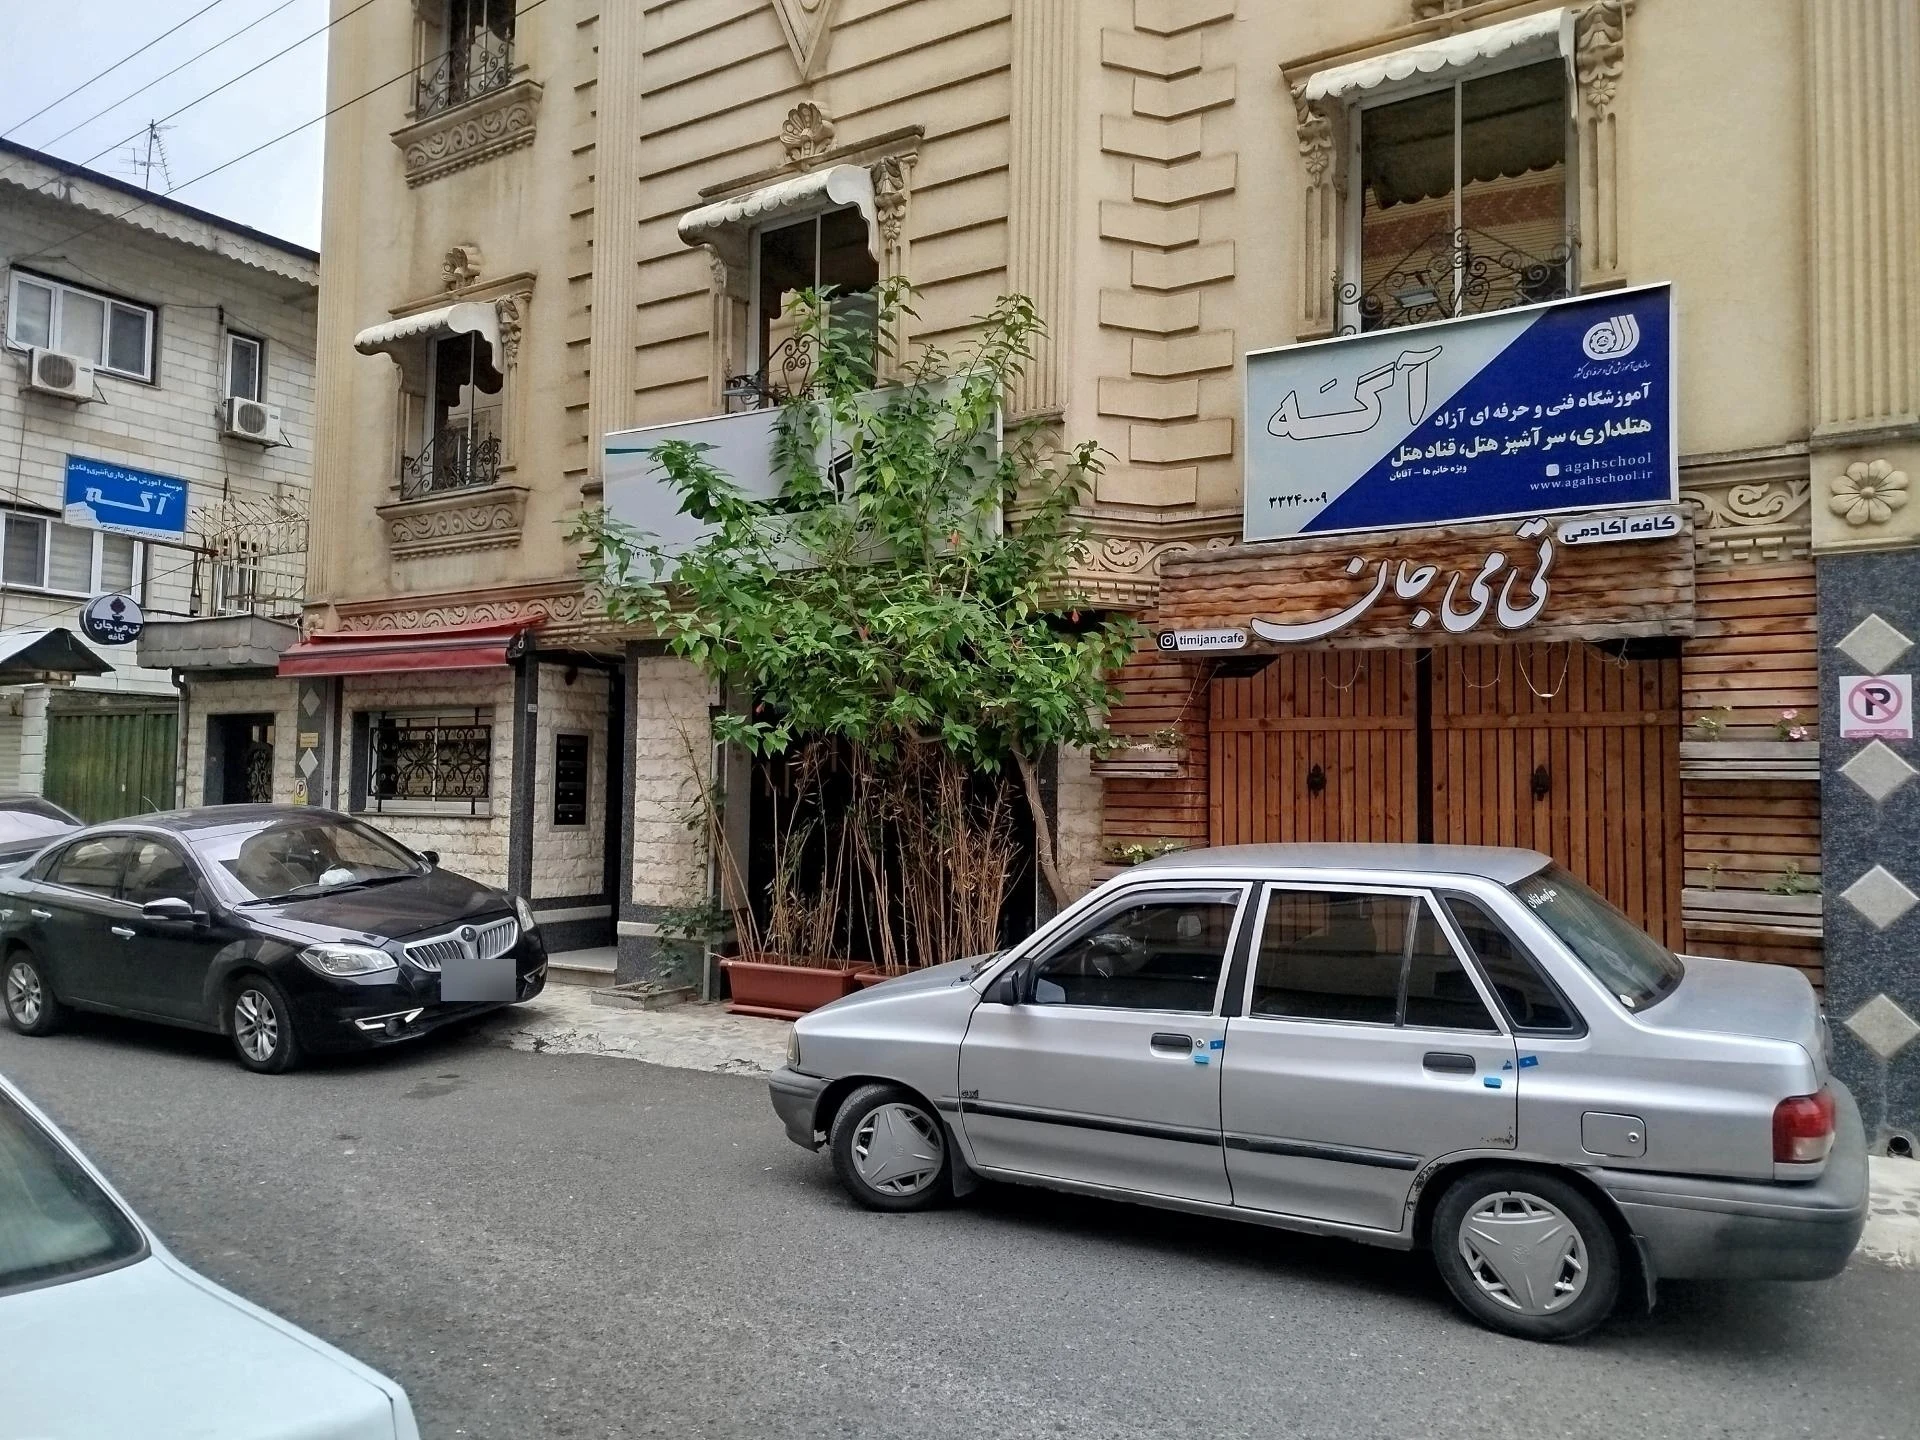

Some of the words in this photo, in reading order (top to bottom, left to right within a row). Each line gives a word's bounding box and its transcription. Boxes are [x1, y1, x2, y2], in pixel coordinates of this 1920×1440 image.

[1545, 393, 1575, 416] فنی
[1578, 381, 1652, 409] آموزشگاه
[1435, 407, 1467, 429] آزاد
[1469, 406, 1489, 426] ای
[1492, 402, 1530, 422] حرفه
[1534, 405, 1542, 419] و
[1500, 426, 1543, 455] آشپز
[1541, 432, 1567, 451] سر
[1569, 416, 1652, 447] هتلداری،
[1424, 436, 1457, 459] قناد
[1458, 434, 1499, 458] هتل،
[1391, 445, 1423, 468] هتل
[1565, 453, 1652, 473] agahschool
[1389, 468, 1413, 481] آقایان
[1422, 467, 1431, 475] ها
[1432, 465, 1449, 476] خانم
[1450, 464, 1468, 474] ویژه
[1529, 469, 1654, 491] www.agahschool.ir
[1268, 491, 1328, 509] ۳۳۲۴۰۰۰۹
[1564, 517, 1629, 543] آکادمی
[1630, 515, 1675, 533] کافه
[1249, 554, 1443, 644] جان
[1439, 550, 1507, 634] می
[93, 620, 113, 631] جان
[114, 624, 128, 633] می
[107, 633, 125, 641] کافه
[1179, 632, 1245, 647] timijan.cafe
[1865, 687, 1891, 716] P
